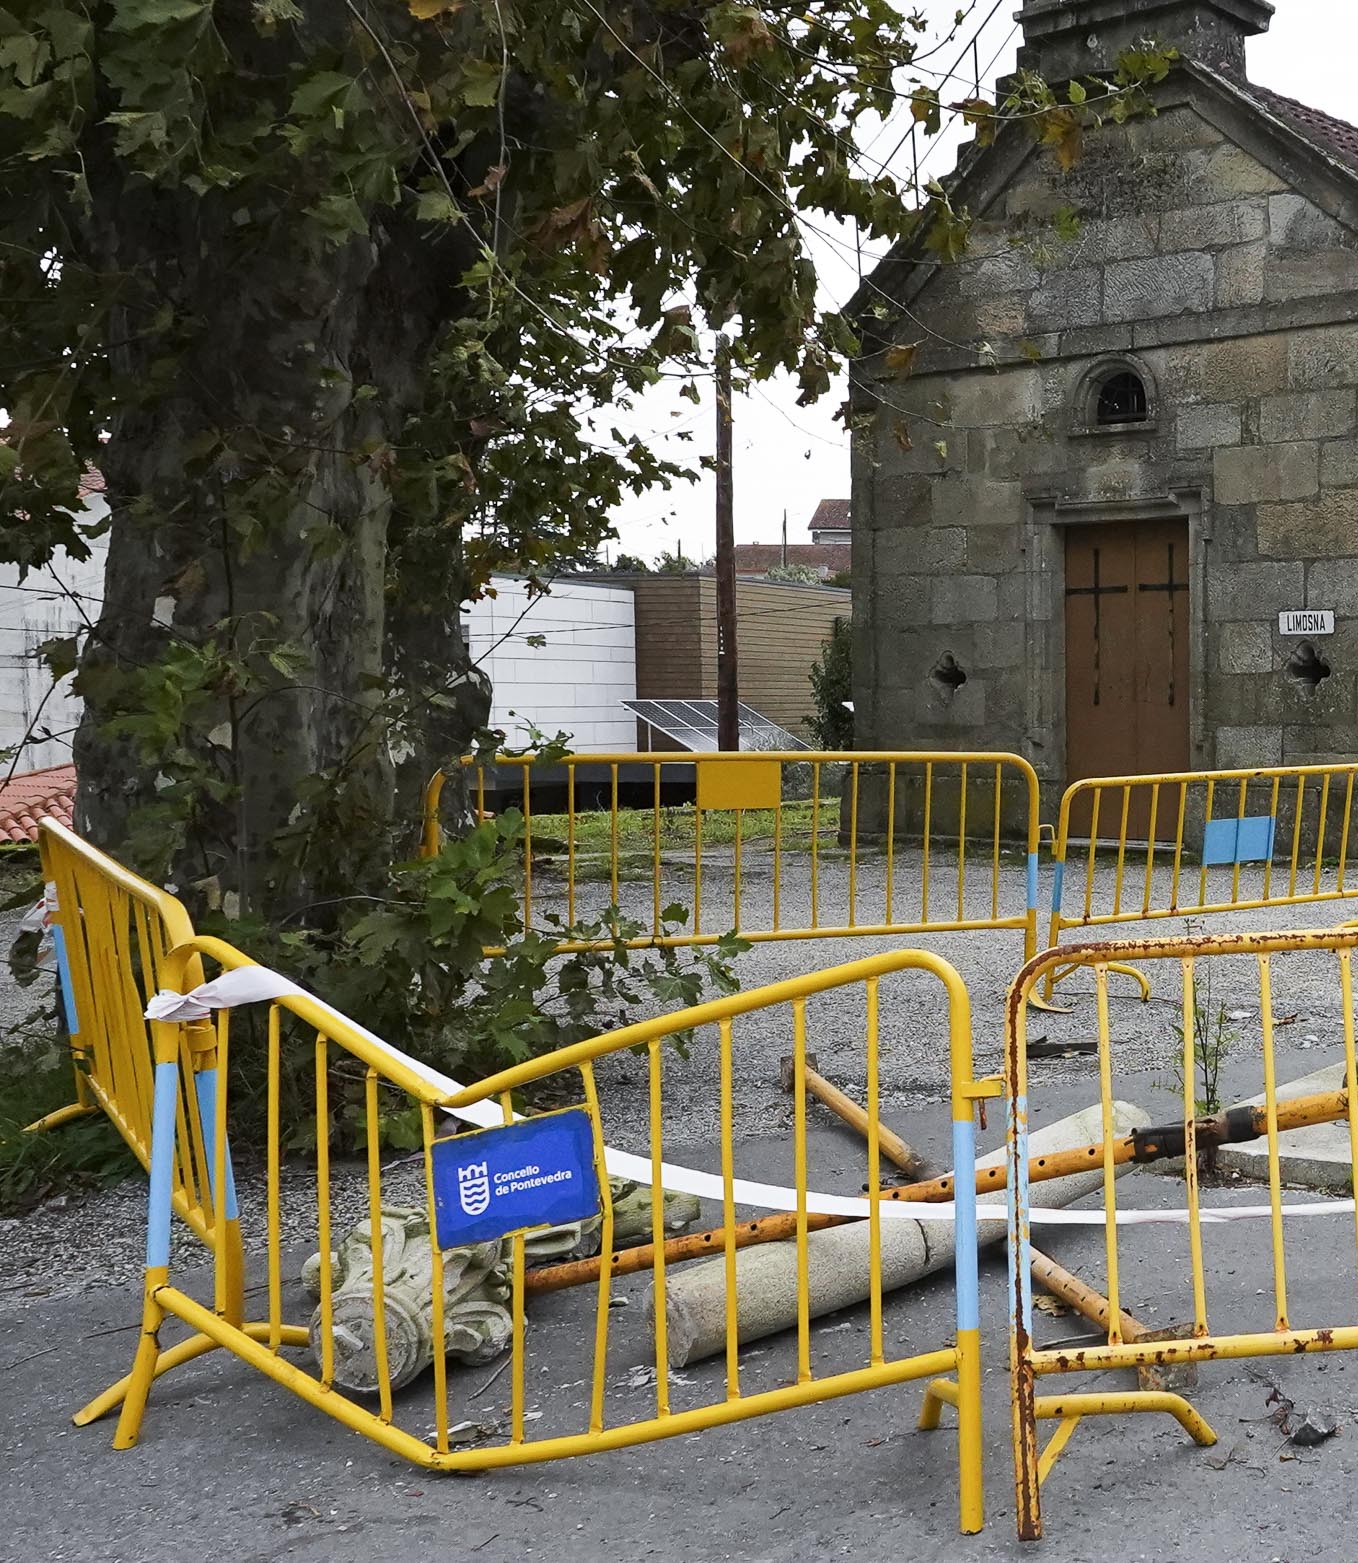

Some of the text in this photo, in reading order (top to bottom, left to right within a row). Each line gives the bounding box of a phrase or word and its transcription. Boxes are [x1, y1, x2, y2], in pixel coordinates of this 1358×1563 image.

[1286, 614, 1326, 632] LIMOSNA
[493, 1165, 540, 1184] Concello
[495, 1170, 572, 1196] de Pontevedra
